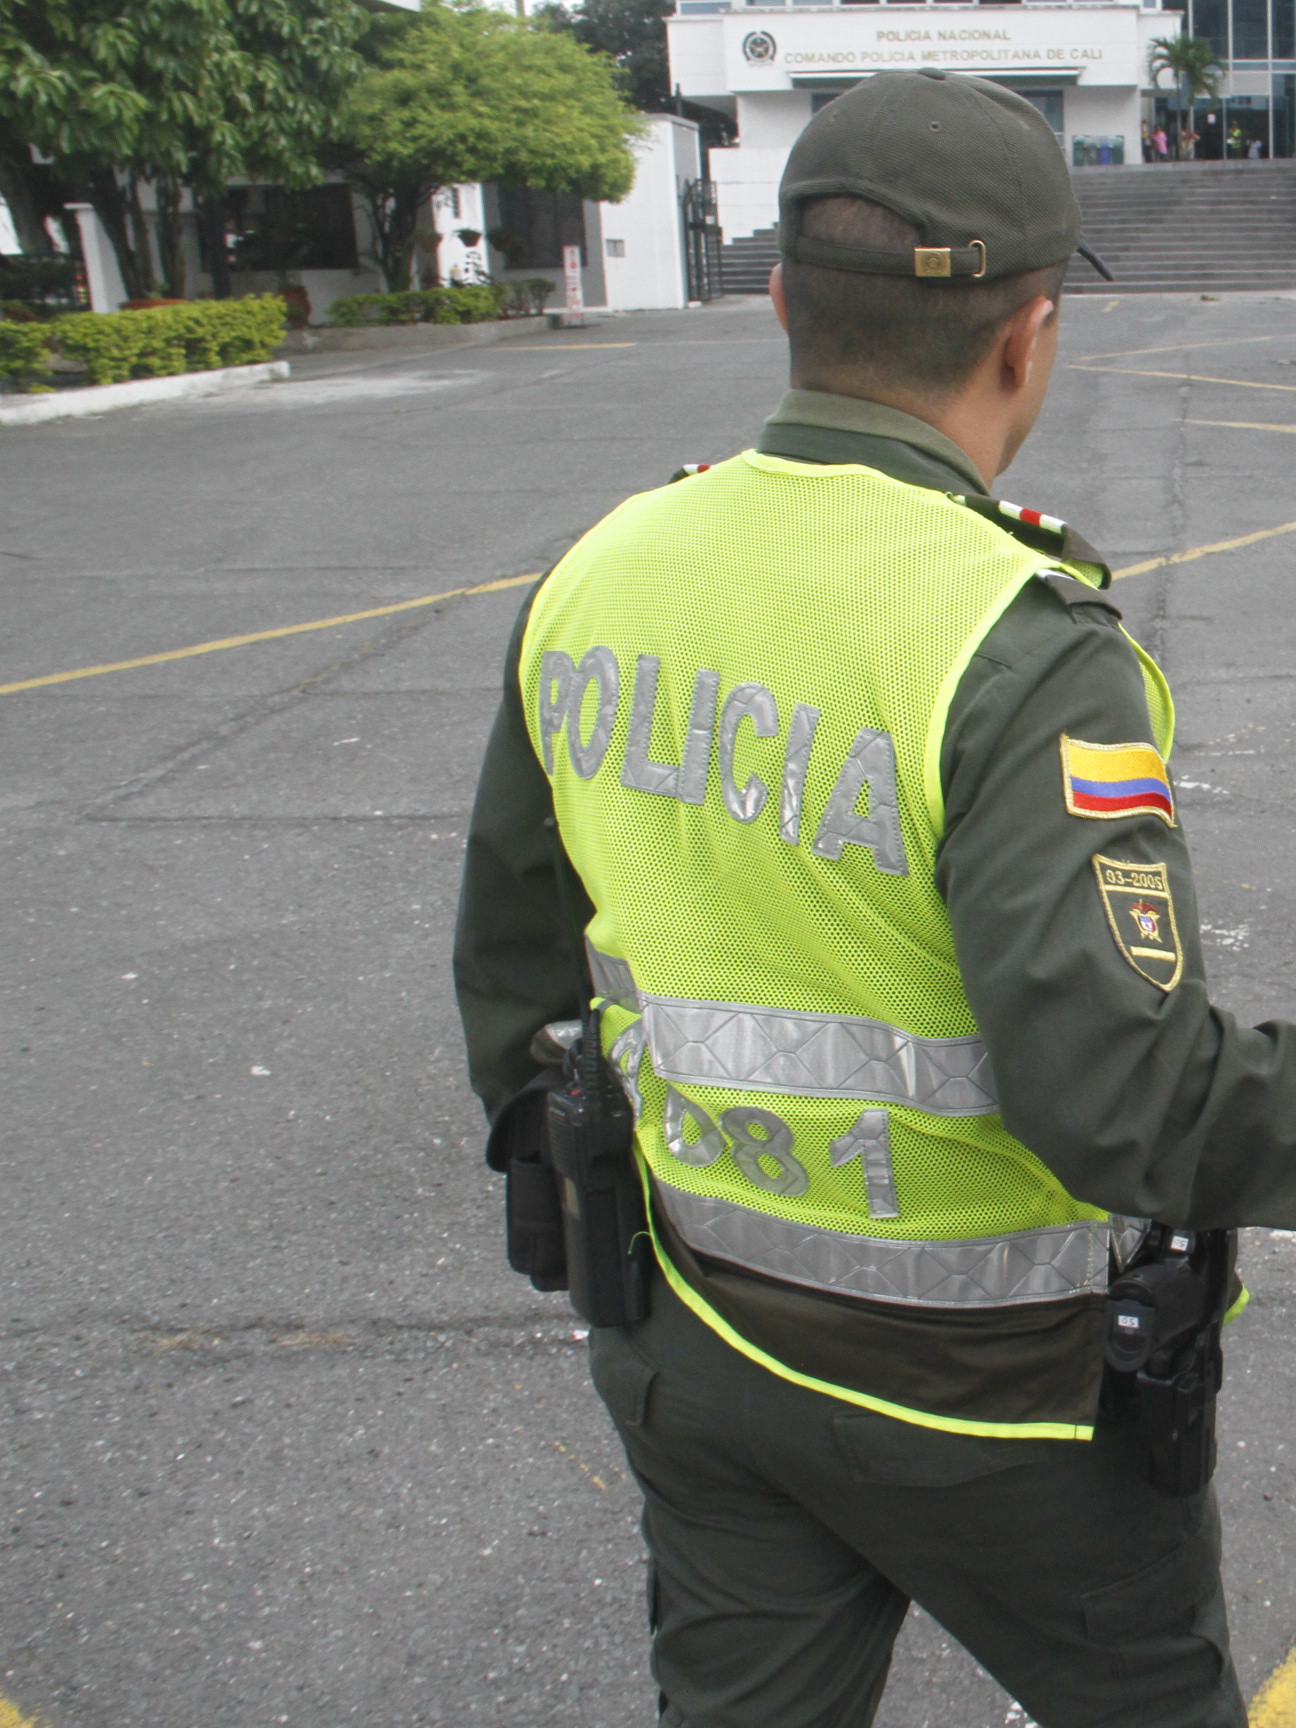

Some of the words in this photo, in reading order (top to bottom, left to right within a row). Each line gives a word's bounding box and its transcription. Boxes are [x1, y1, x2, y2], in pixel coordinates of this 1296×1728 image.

[876, 29, 932, 42] POLICIA
[937, 29, 1011, 41] NACIONAL
[784, 52, 857, 64] COMANDO
[861, 51, 917, 63] POLICIA
[920, 49, 1042, 62] METROPOLITANA
[1046, 49, 1066, 61] DE
[1069, 48, 1103, 60] CALI
[538, 644, 910, 878] POLICIA
